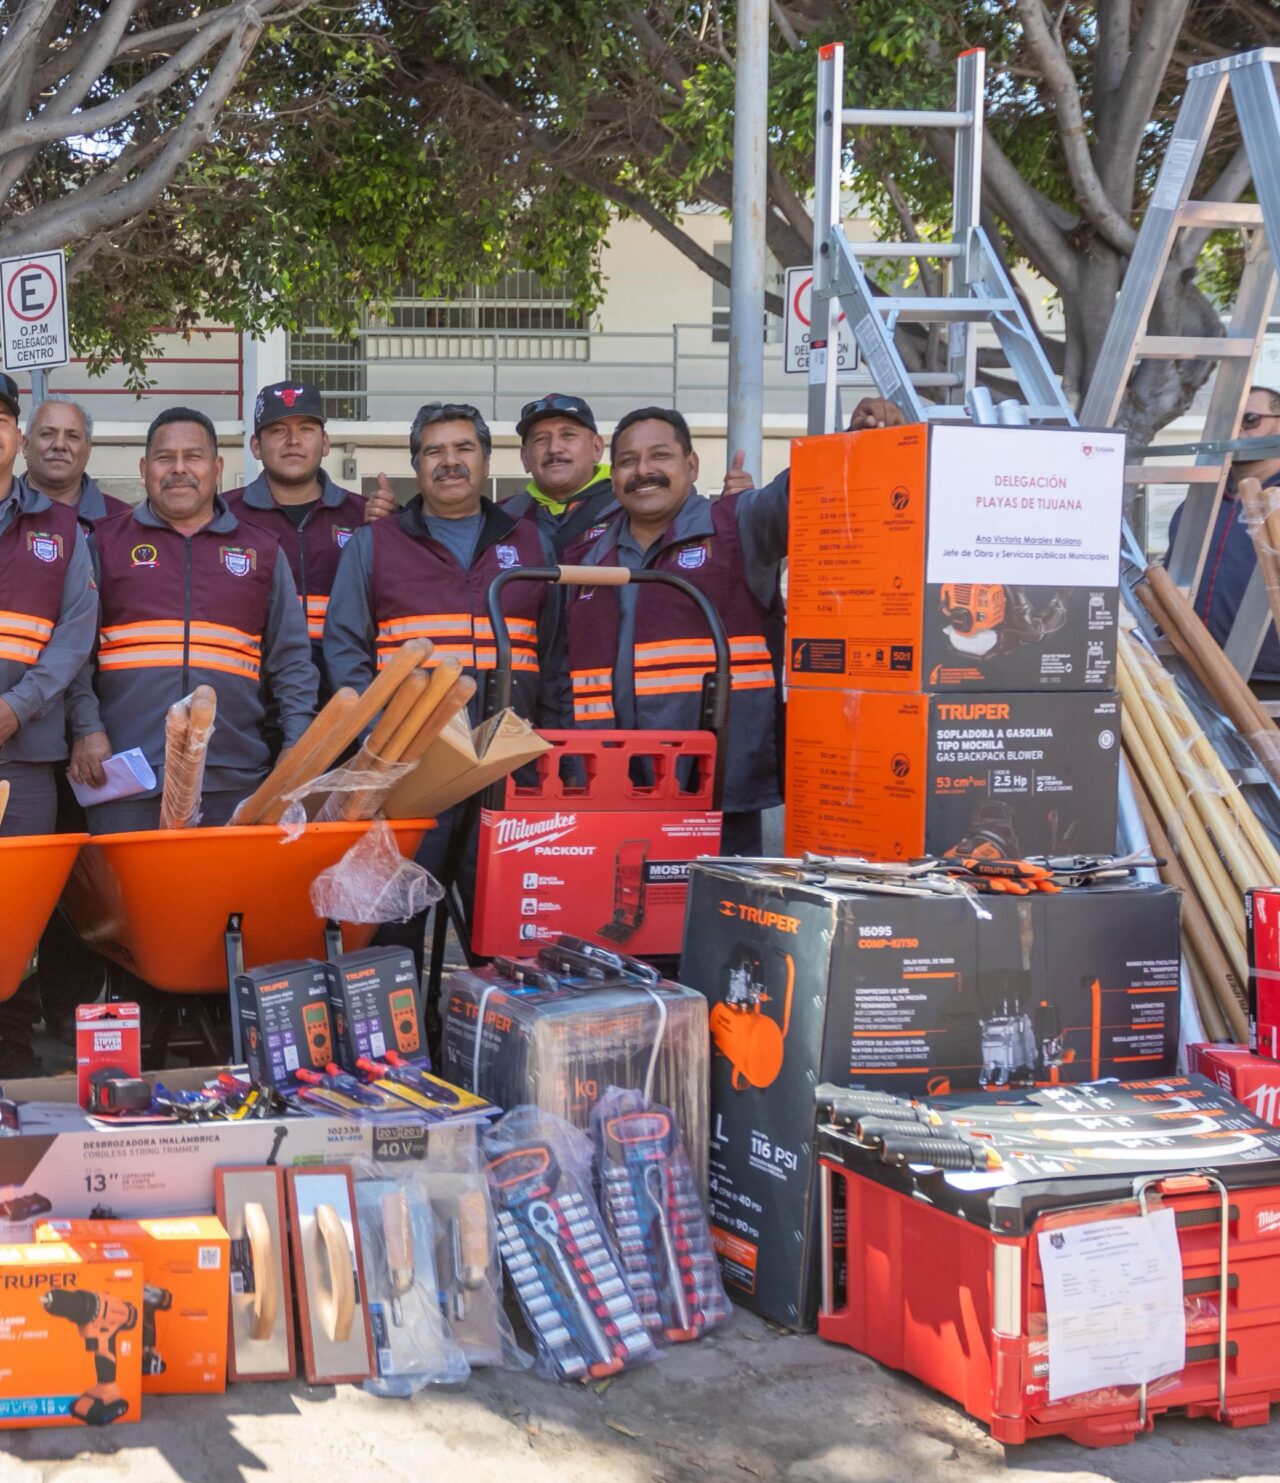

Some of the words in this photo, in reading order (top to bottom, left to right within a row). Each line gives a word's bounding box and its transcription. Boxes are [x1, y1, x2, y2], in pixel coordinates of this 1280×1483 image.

[20, 274, 44, 312] E
[12, 334, 58, 350] DELEGACION
[17, 348, 54, 362] CENTRO
[994, 474, 1066, 488] DELEGACIÓN
[976, 496, 1018, 508] PLAYAS
[1021, 498, 1034, 510] DE
[1038, 498, 1083, 510] TIJUANA
[976, 534, 992, 544] Ana
[994, 535, 1021, 544] Victoria
[1024, 536, 1053, 545] Morales
[943, 549, 958, 558] Jefe
[974, 549, 994, 558] Obra
[1002, 550, 1034, 559] Servicios
[1036, 551, 1066, 560] públicos
[1068, 552, 1109, 562] Municipales
[937, 704, 1010, 720] TRUPER
[936, 728, 994, 740] SOPLADORA
[996, 728, 1004, 738] A
[1006, 728, 1054, 738] GASOLINA
[936, 741, 960, 750] TIPO
[962, 740, 1004, 750] MOCHILA
[936, 752, 956, 762] GAS
[958, 751, 1006, 761] BACKPACK
[1007, 750, 1044, 760] BLOWER
[936, 777, 951, 788] 53
[994, 776, 1012, 786] 2.5
[1014, 776, 1028, 787] Hp
[1036, 782, 1044, 792] 2
[494, 813, 578, 844] Milwaukee
[534, 846, 598, 856] PACKOUT
[738, 904, 802, 934] TRUPER
[858, 926, 892, 936] 16095
[346, 968, 376, 982] TRUPER
[259, 980, 289, 993] TRUPER
[464, 1002, 512, 1033] TRPER
[575, 1076, 598, 1100] kg
[1119, 1078, 1191, 1090] TRUPER
[716, 1113, 729, 1142] L
[83, 1138, 156, 1150] DESBROZADORA
[159, 1134, 220, 1145] INALÁMBRICA
[378, 1143, 400, 1156] 40
[402, 1142, 412, 1155] V
[83, 1150, 127, 1159] CORDLESS
[130, 1148, 159, 1156] STRING
[163, 1146, 200, 1154] TRIMMER
[750, 1137, 770, 1158] 116
[774, 1146, 798, 1171] PSI
[739, 1194, 751, 1210] 40
[736, 1220, 748, 1233] 90
